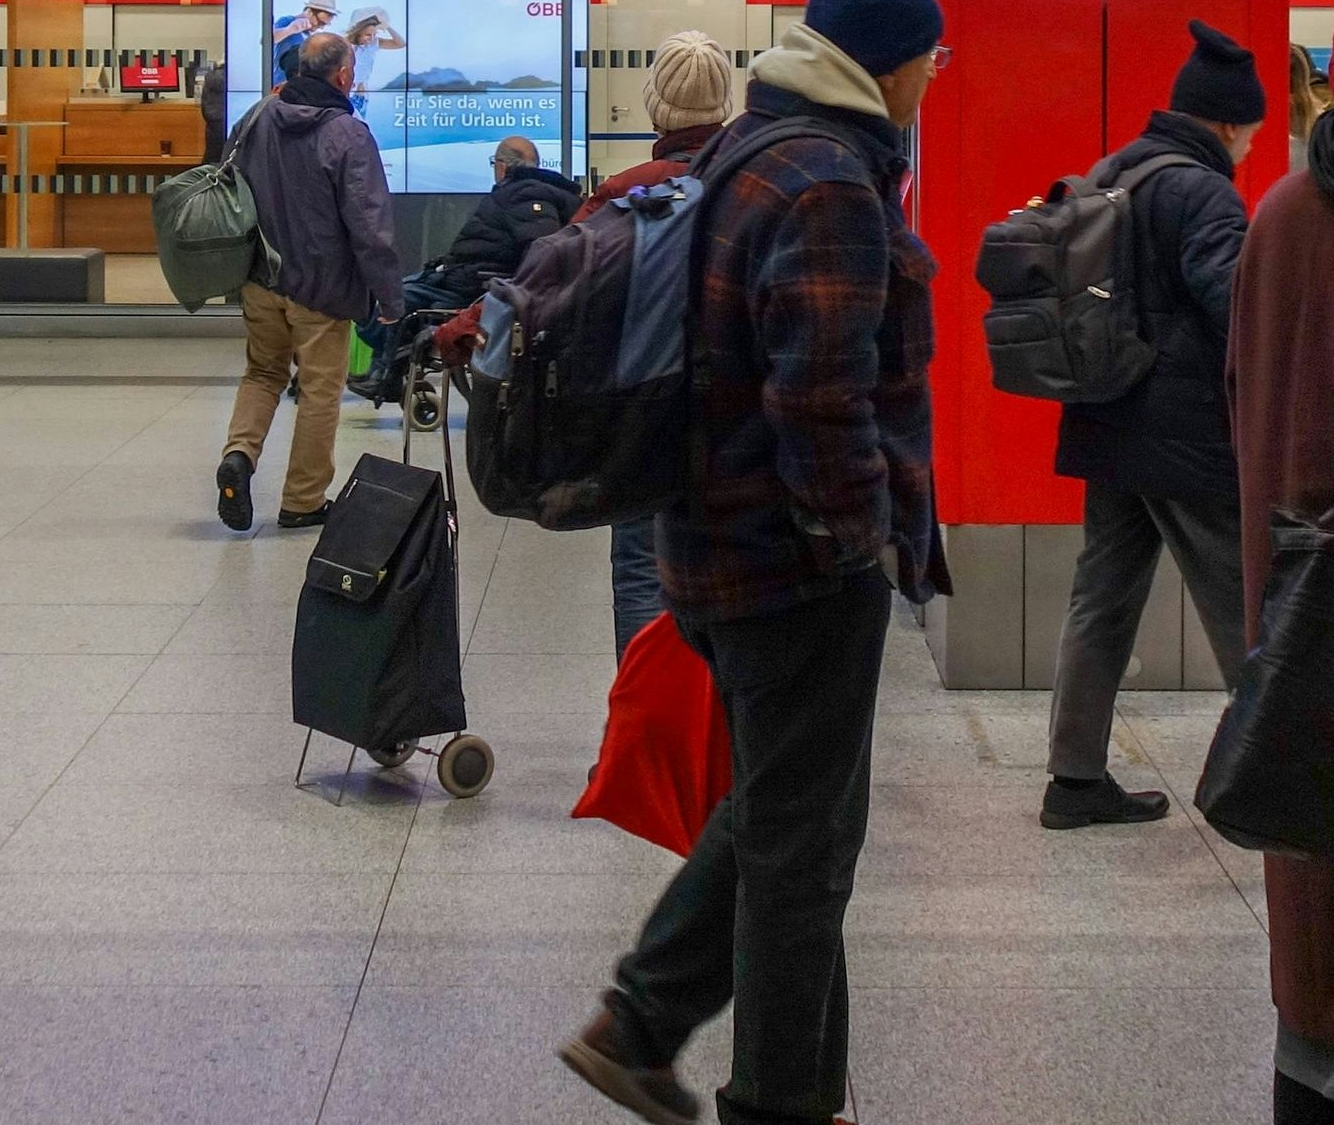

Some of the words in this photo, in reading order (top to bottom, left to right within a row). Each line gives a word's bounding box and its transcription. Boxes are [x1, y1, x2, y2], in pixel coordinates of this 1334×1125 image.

[395, 95, 423, 110] Für
[428, 95, 452, 110] Sie
[457, 95, 482, 111] da,
[488, 98, 534, 110] wenn
[539, 98, 557, 110] es
[394, 113, 428, 127] Zeit
[432, 112, 457, 127] für
[461, 112, 516, 127] Urlaub
[521, 113, 546, 128] ist.
